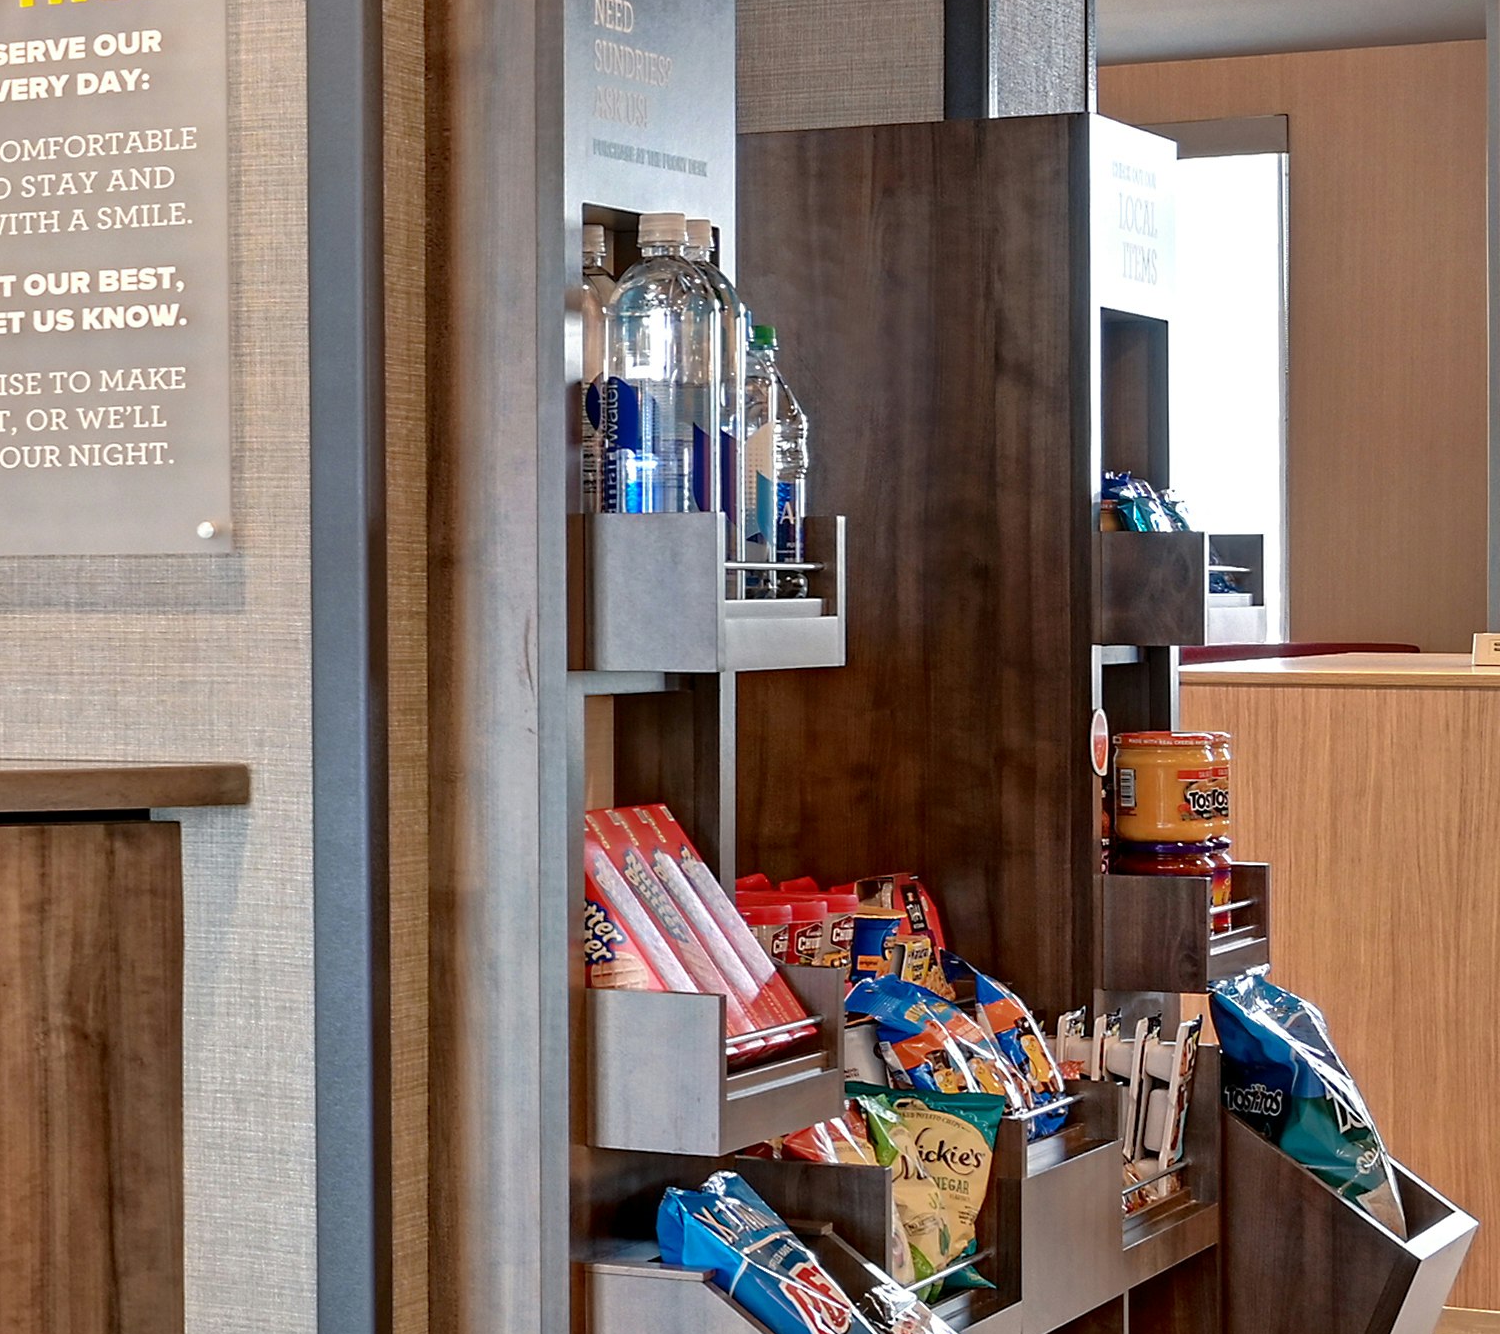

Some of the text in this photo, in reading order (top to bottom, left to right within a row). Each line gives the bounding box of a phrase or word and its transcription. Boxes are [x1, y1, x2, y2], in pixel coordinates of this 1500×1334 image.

[92, 29, 162, 57] OUR
[594, 39, 674, 87] SUNDRIES?
[76, 68, 150, 96] DAY:
[593, 85, 648, 129] ASK US!
[20, 170, 99, 198] STAY
[106, 166, 175, 192] AND
[67, 208, 90, 232] A
[96, 202, 193, 230] SMILE.
[1118, 191, 1158, 239] LOCAL
[1122, 241, 1158, 286] ITEMS
[23, 271, 91, 296] OUR
[98, 266, 185, 293] BEST,
[33, 308, 75, 333] US
[82, 303, 187, 330] KNOW.
[48, 370, 91, 394] TO
[99, 366, 186, 392] MAKE
[26, 408, 69, 432] OR
[75, 405, 167, 430] WE'LL
[68, 442, 175, 467] NIGHT.
[585, 903, 622, 942] tter
[932, 1176, 970, 1195] NEGAR
